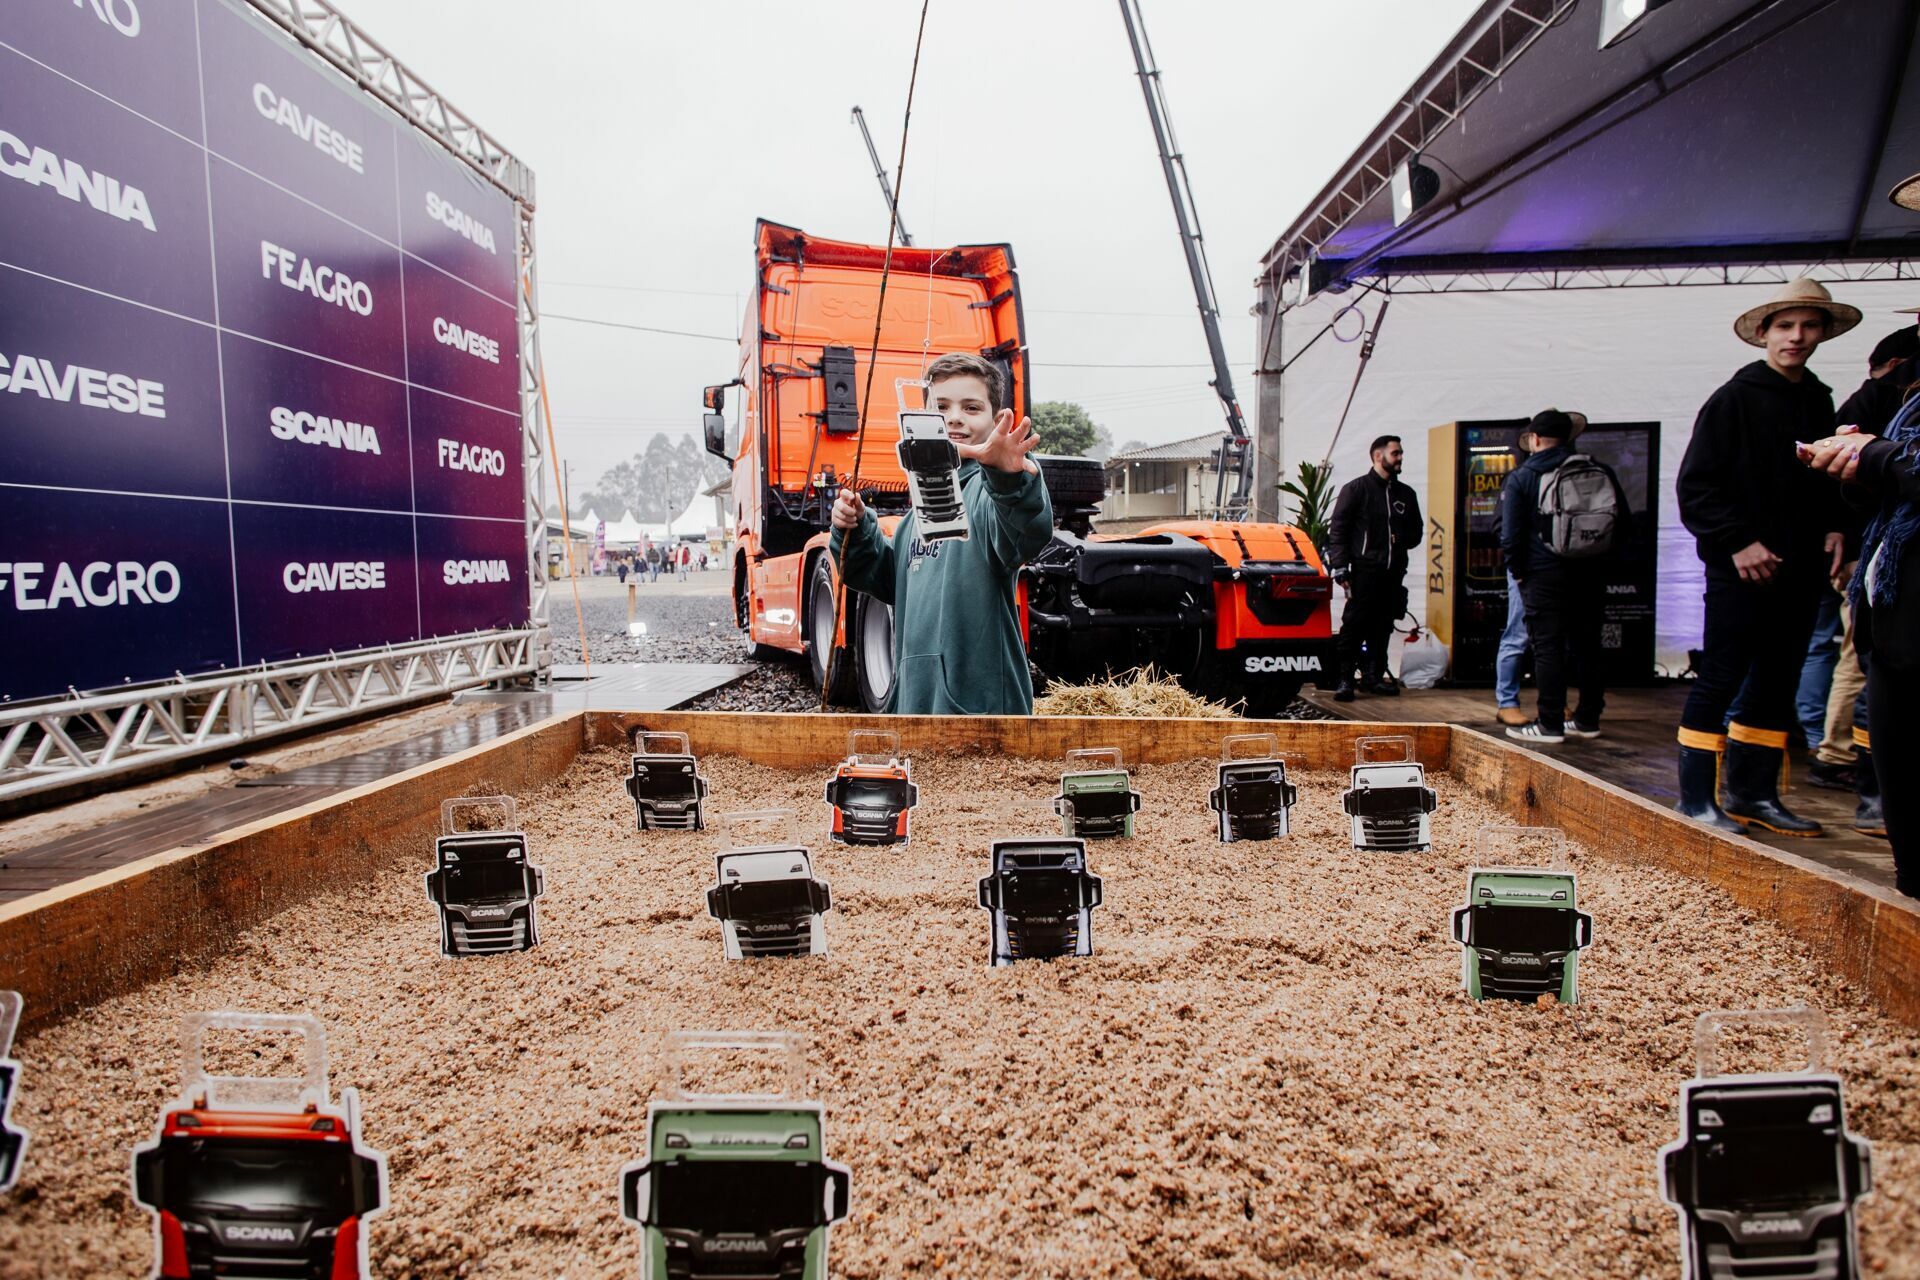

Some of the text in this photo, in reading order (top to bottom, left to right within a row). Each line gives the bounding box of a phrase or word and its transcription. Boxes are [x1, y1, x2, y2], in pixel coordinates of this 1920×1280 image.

[253, 83, 364, 174] CAVESE
[0, 129, 157, 232] CANIA
[426, 191, 496, 255] SCANIA
[261, 240, 373, 316] FEAGRO
[433, 317, 499, 364] CAVESE
[270, 406, 381, 455] SCANIA
[438, 438, 505, 477] FEAGRO
[1474, 474, 1503, 492] BAL
[1430, 516, 1444, 594] BALY
[283, 562, 385, 593] CAVESE
[443, 560, 510, 585] SCANIA
[1606, 584, 1637, 594] ANIA
[1245, 655, 1322, 673] SCANIA
[470, 908, 506, 917] SCANIA
[755, 923, 791, 932] SCANIA
[1502, 956, 1542, 966] SCANIA
[226, 1225, 295, 1242] SCANIA
[1741, 1219, 1803, 1234] SCANIA
[703, 1240, 768, 1253] SCANIA
